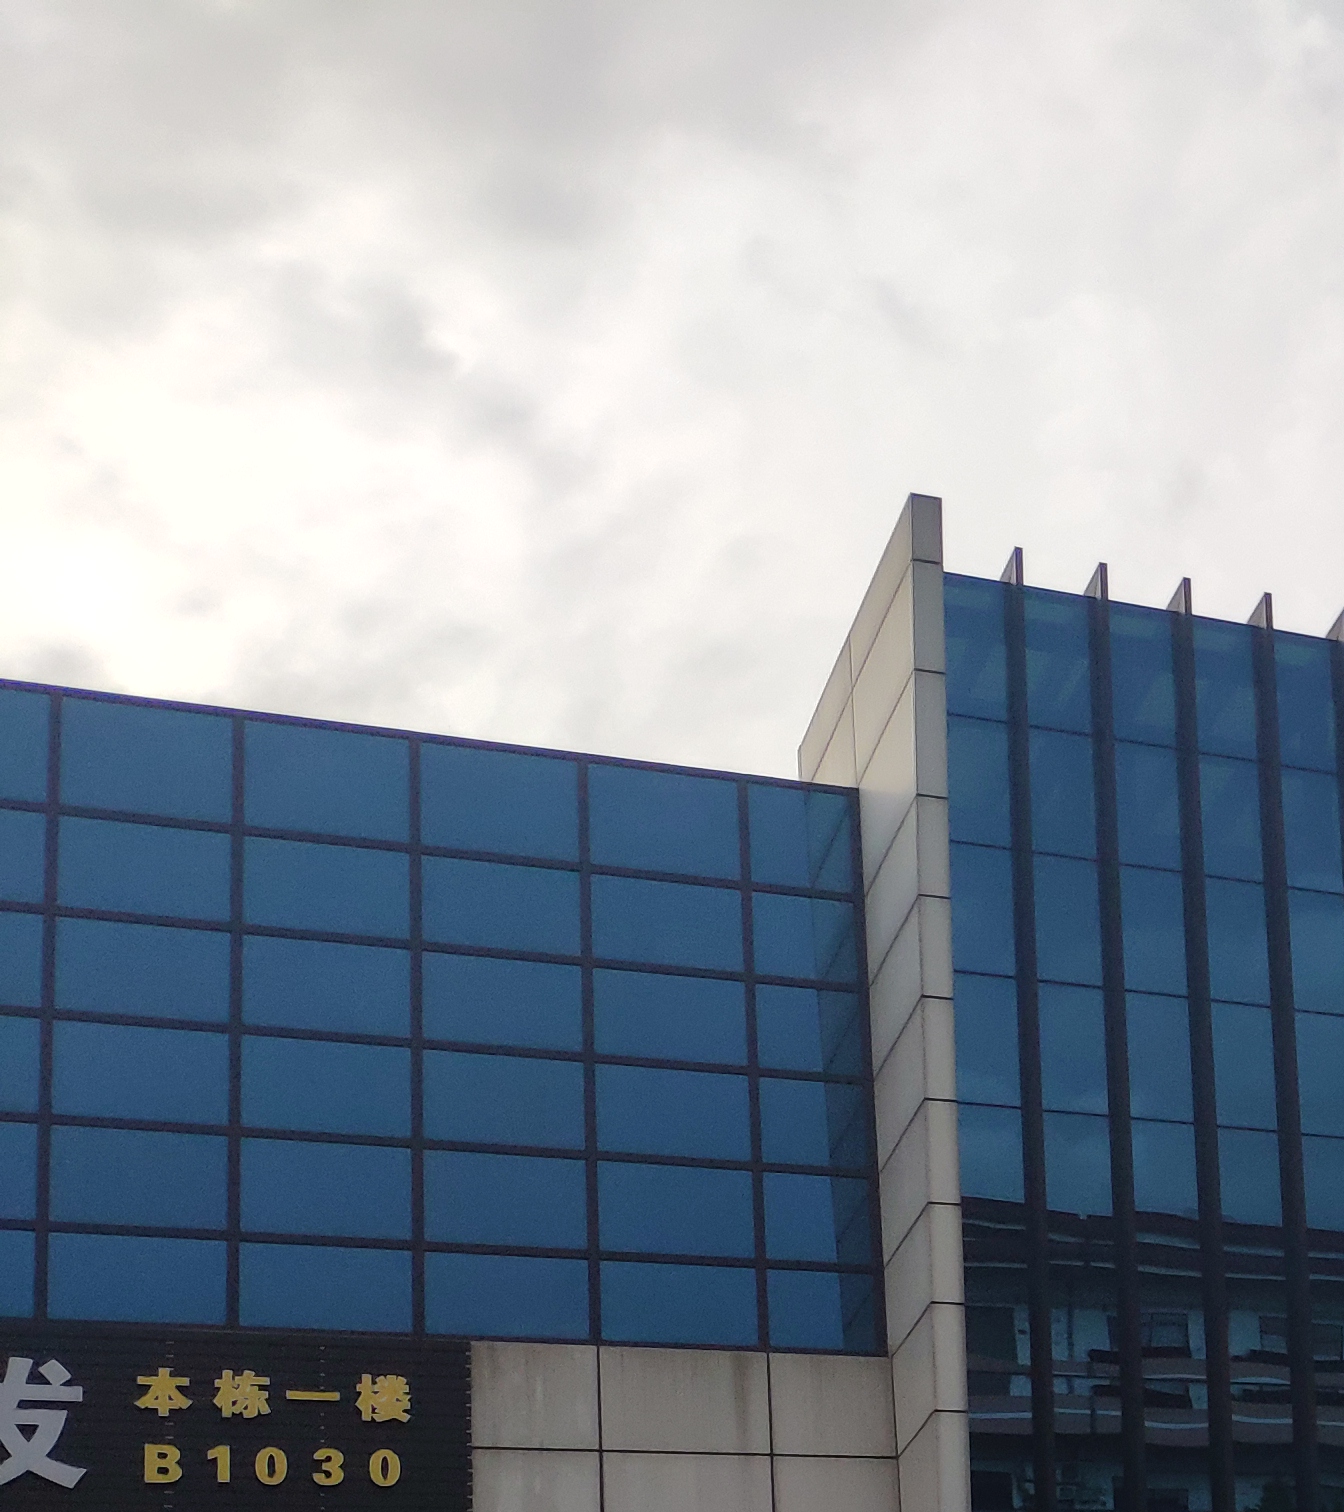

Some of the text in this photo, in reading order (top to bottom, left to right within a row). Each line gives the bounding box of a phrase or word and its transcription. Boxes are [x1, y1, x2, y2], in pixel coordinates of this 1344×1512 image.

[135, 1367, 412, 1423] 本栋一楼
[143, 1444, 402, 1487] B1030
